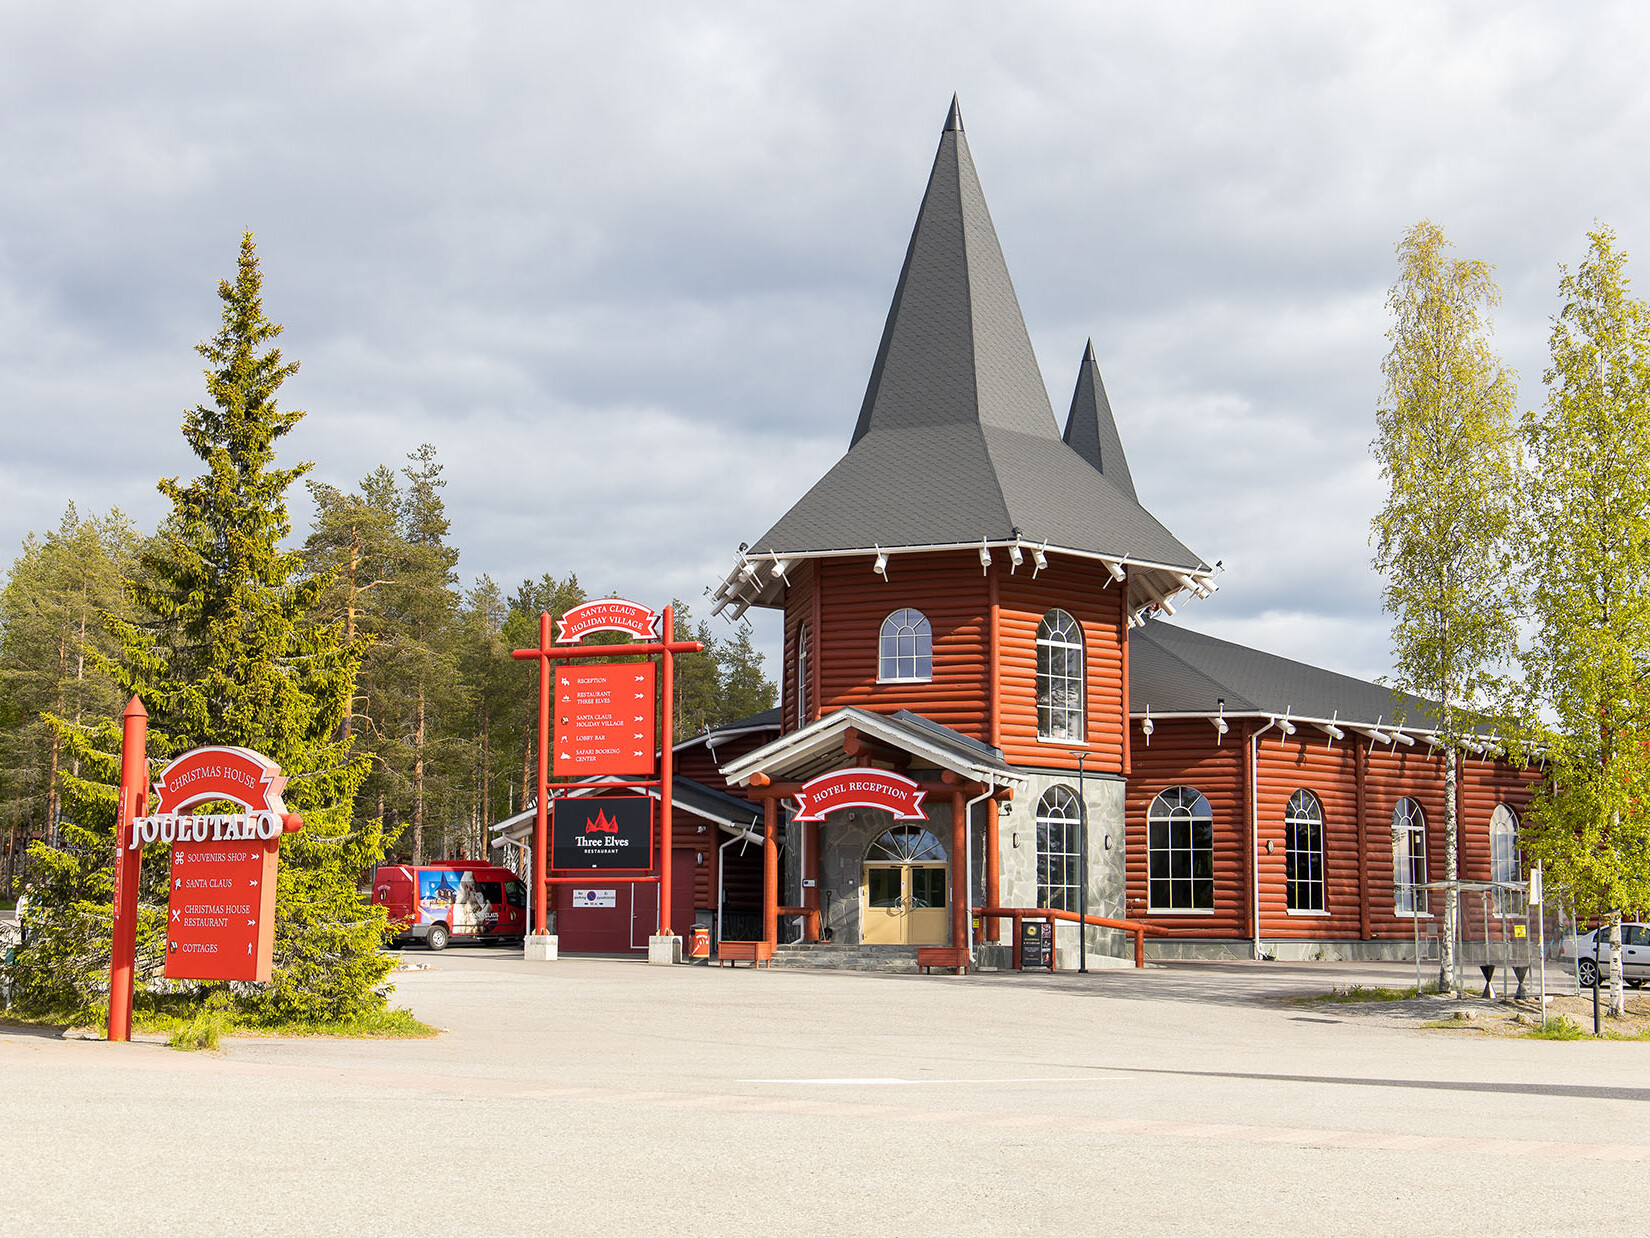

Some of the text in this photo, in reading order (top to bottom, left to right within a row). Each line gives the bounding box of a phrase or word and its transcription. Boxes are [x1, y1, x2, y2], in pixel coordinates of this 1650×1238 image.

[580, 605, 636, 619] SANTA CLAUS
[570, 616, 644, 633] HOLIDAY VILLAGE
[169, 766, 256, 793] CHRISTMAS HOUSE
[812, 781, 908, 803] HOTEL RECEPTION
[128, 813, 277, 850] JOULUTALO
[575, 836, 629, 847] Three Elves
[187, 852, 247, 862] SOUVENIRS SHOP
[185, 879, 233, 888] SANTA CLAUS
[184, 905, 250, 914] CHRISTMAS HOUSE
[183, 918, 228, 927] RESTAURANT
[182, 943, 218, 953] COTTAGES
